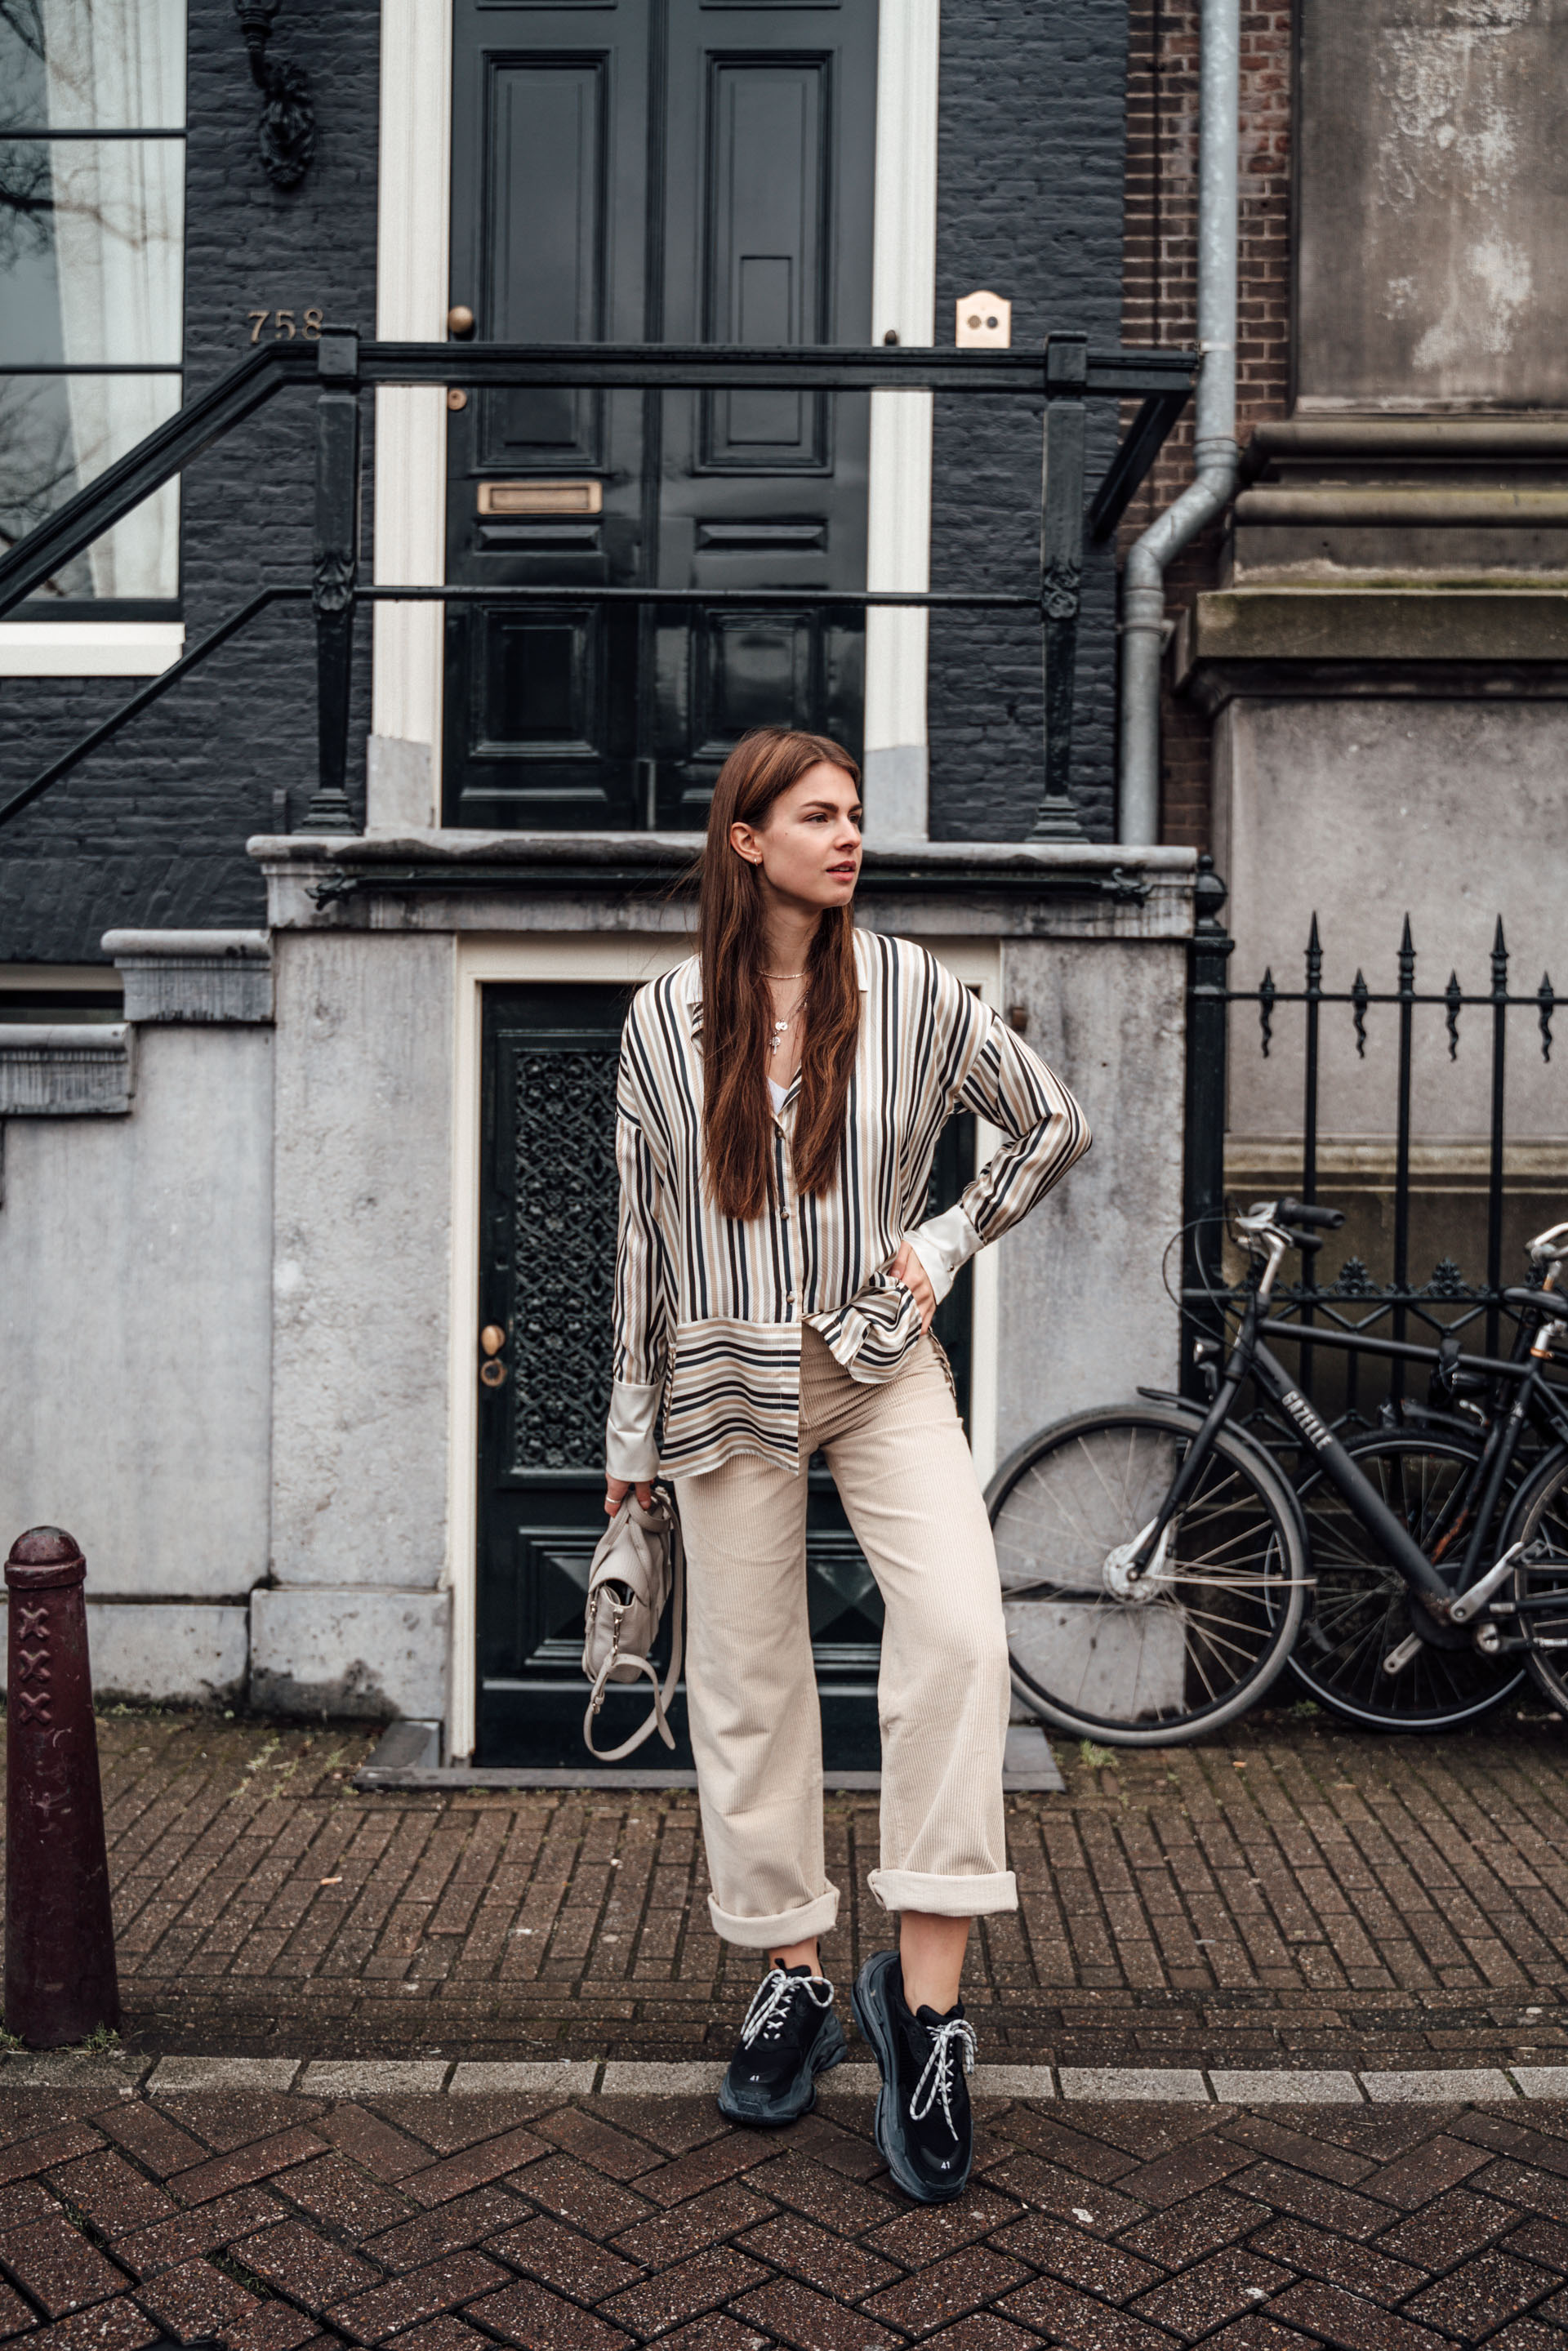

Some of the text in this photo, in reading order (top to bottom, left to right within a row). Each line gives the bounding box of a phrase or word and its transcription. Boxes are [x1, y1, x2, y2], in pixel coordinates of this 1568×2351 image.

[248, 309, 323, 342] 758
[1281, 1390, 1333, 1451] GAZELLE
[941, 2161, 951, 2169] 41
